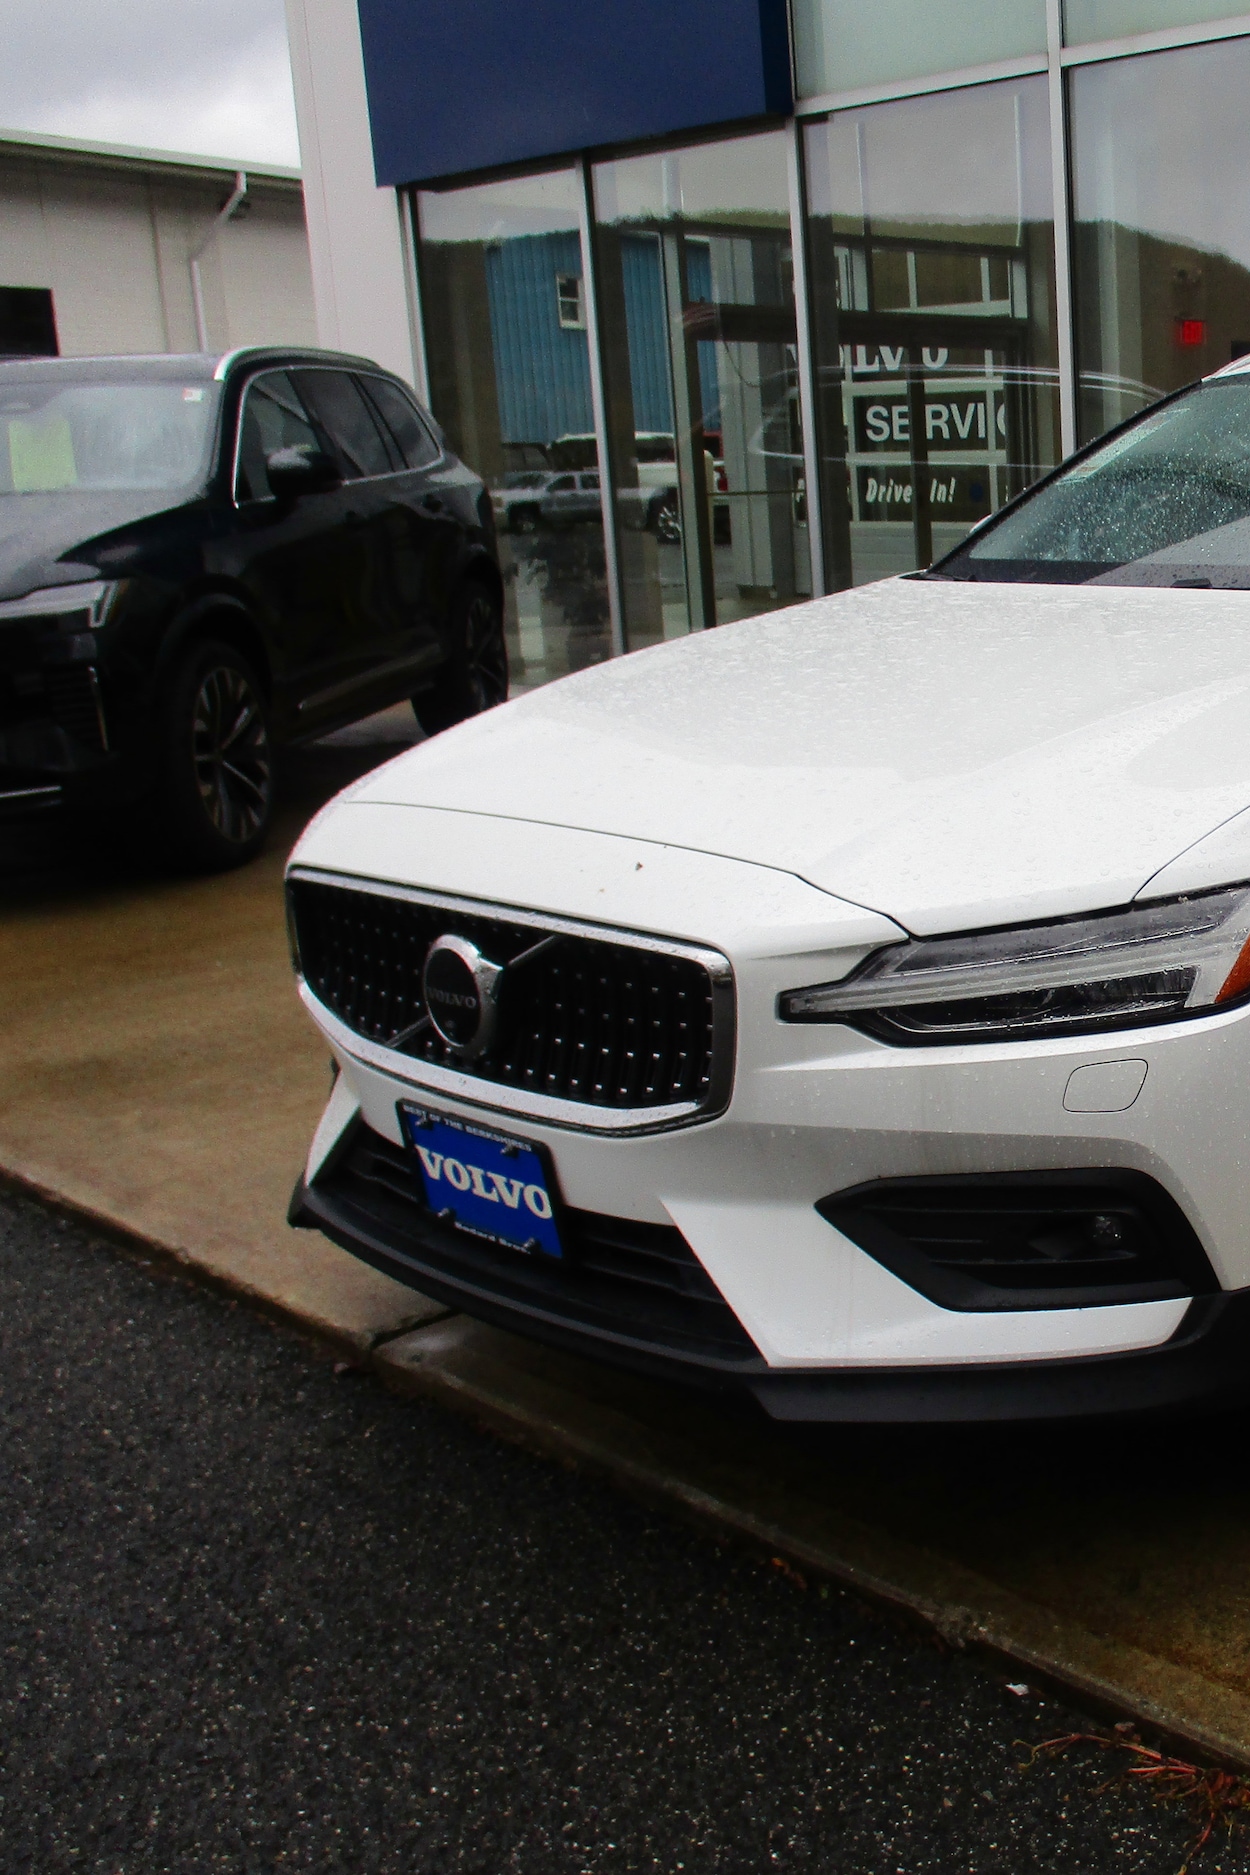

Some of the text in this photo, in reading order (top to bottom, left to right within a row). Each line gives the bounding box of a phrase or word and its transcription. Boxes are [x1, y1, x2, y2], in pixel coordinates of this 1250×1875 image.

[865, 476, 956, 503] Drive In!
[426, 986, 477, 1009] VOLVO
[443, 1117, 464, 1131] THE
[415, 1144, 553, 1220] VOLVO
